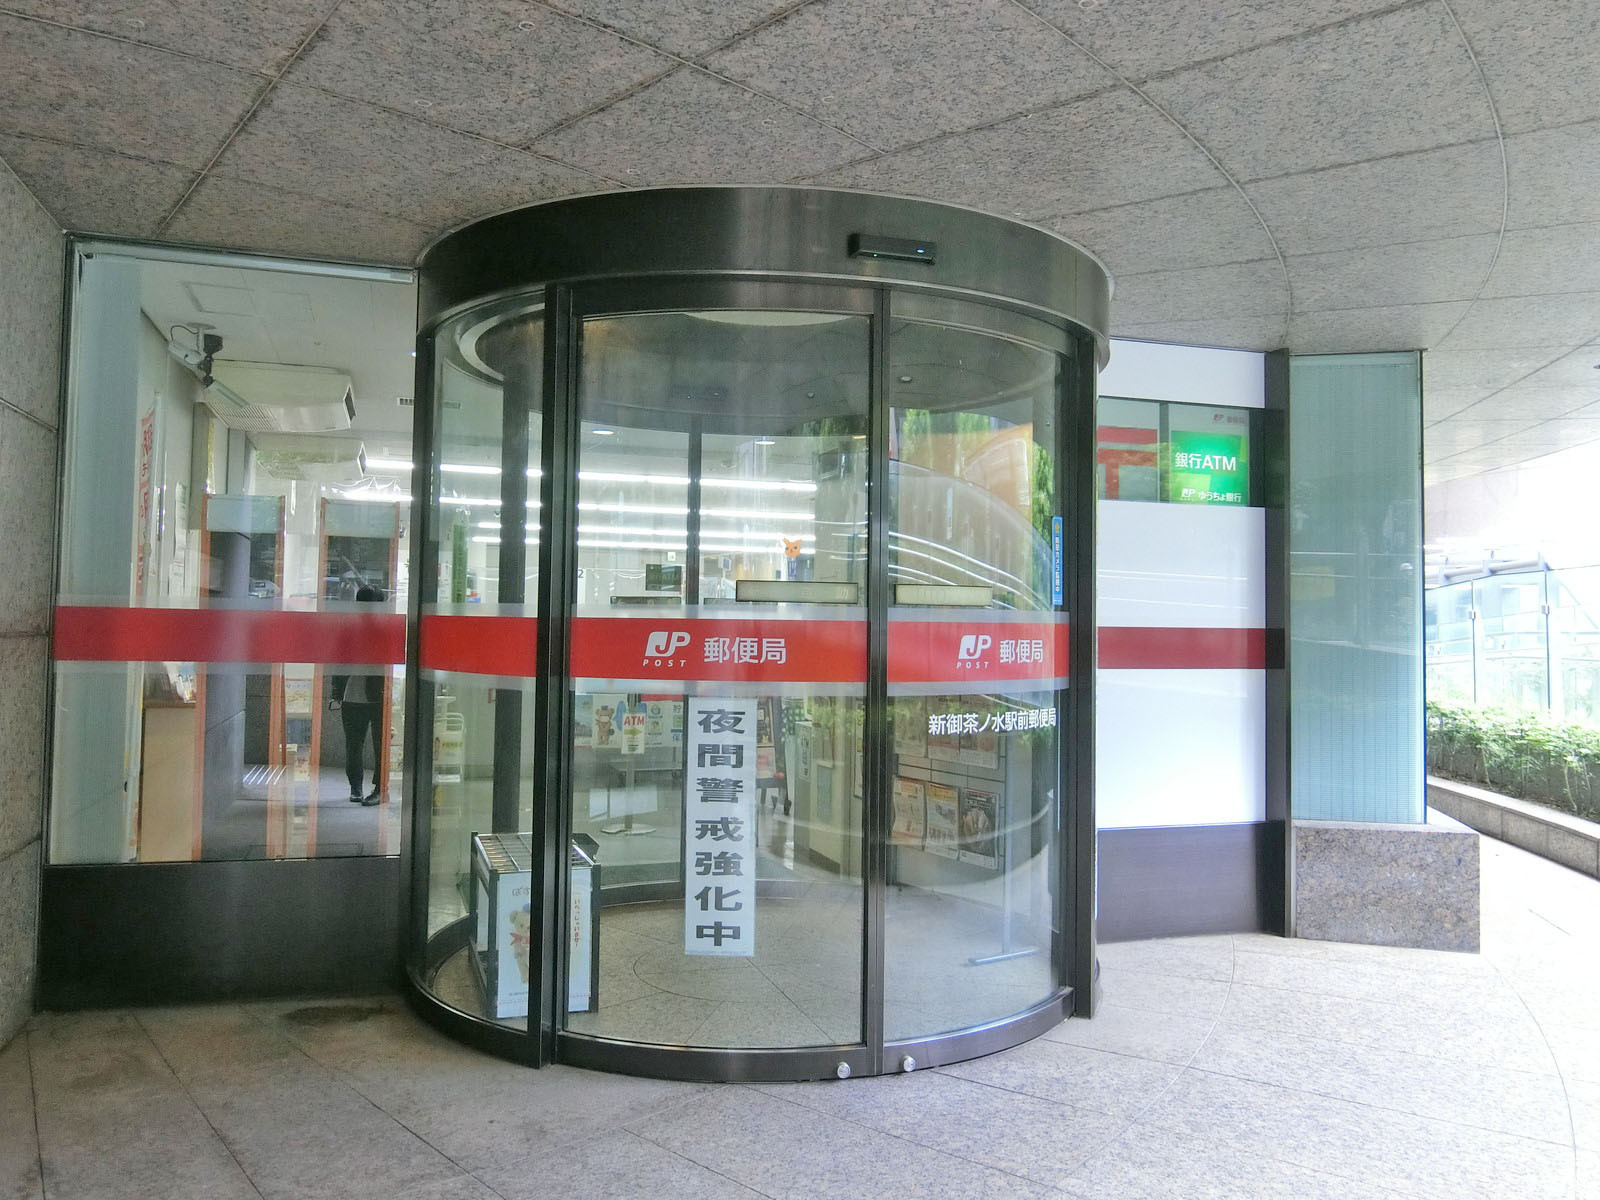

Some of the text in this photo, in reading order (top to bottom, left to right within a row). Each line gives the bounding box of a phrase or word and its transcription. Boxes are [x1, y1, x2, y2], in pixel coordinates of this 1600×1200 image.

[1175, 452, 1237, 471] 銀行ATM
[1198, 491, 1242, 502] ゆうちょ銀行
[645, 631, 787, 664] JP 郵便局
[958, 635, 1043, 664] JP 郵便局
[642, 659, 686, 667] POST
[956, 661, 989, 669] POST
[623, 715, 645, 726] ATM
[928, 708, 1057, 736] 新御茶ノ水駅前郵便局
[694, 709, 746, 947] 夜間警戒強化中
